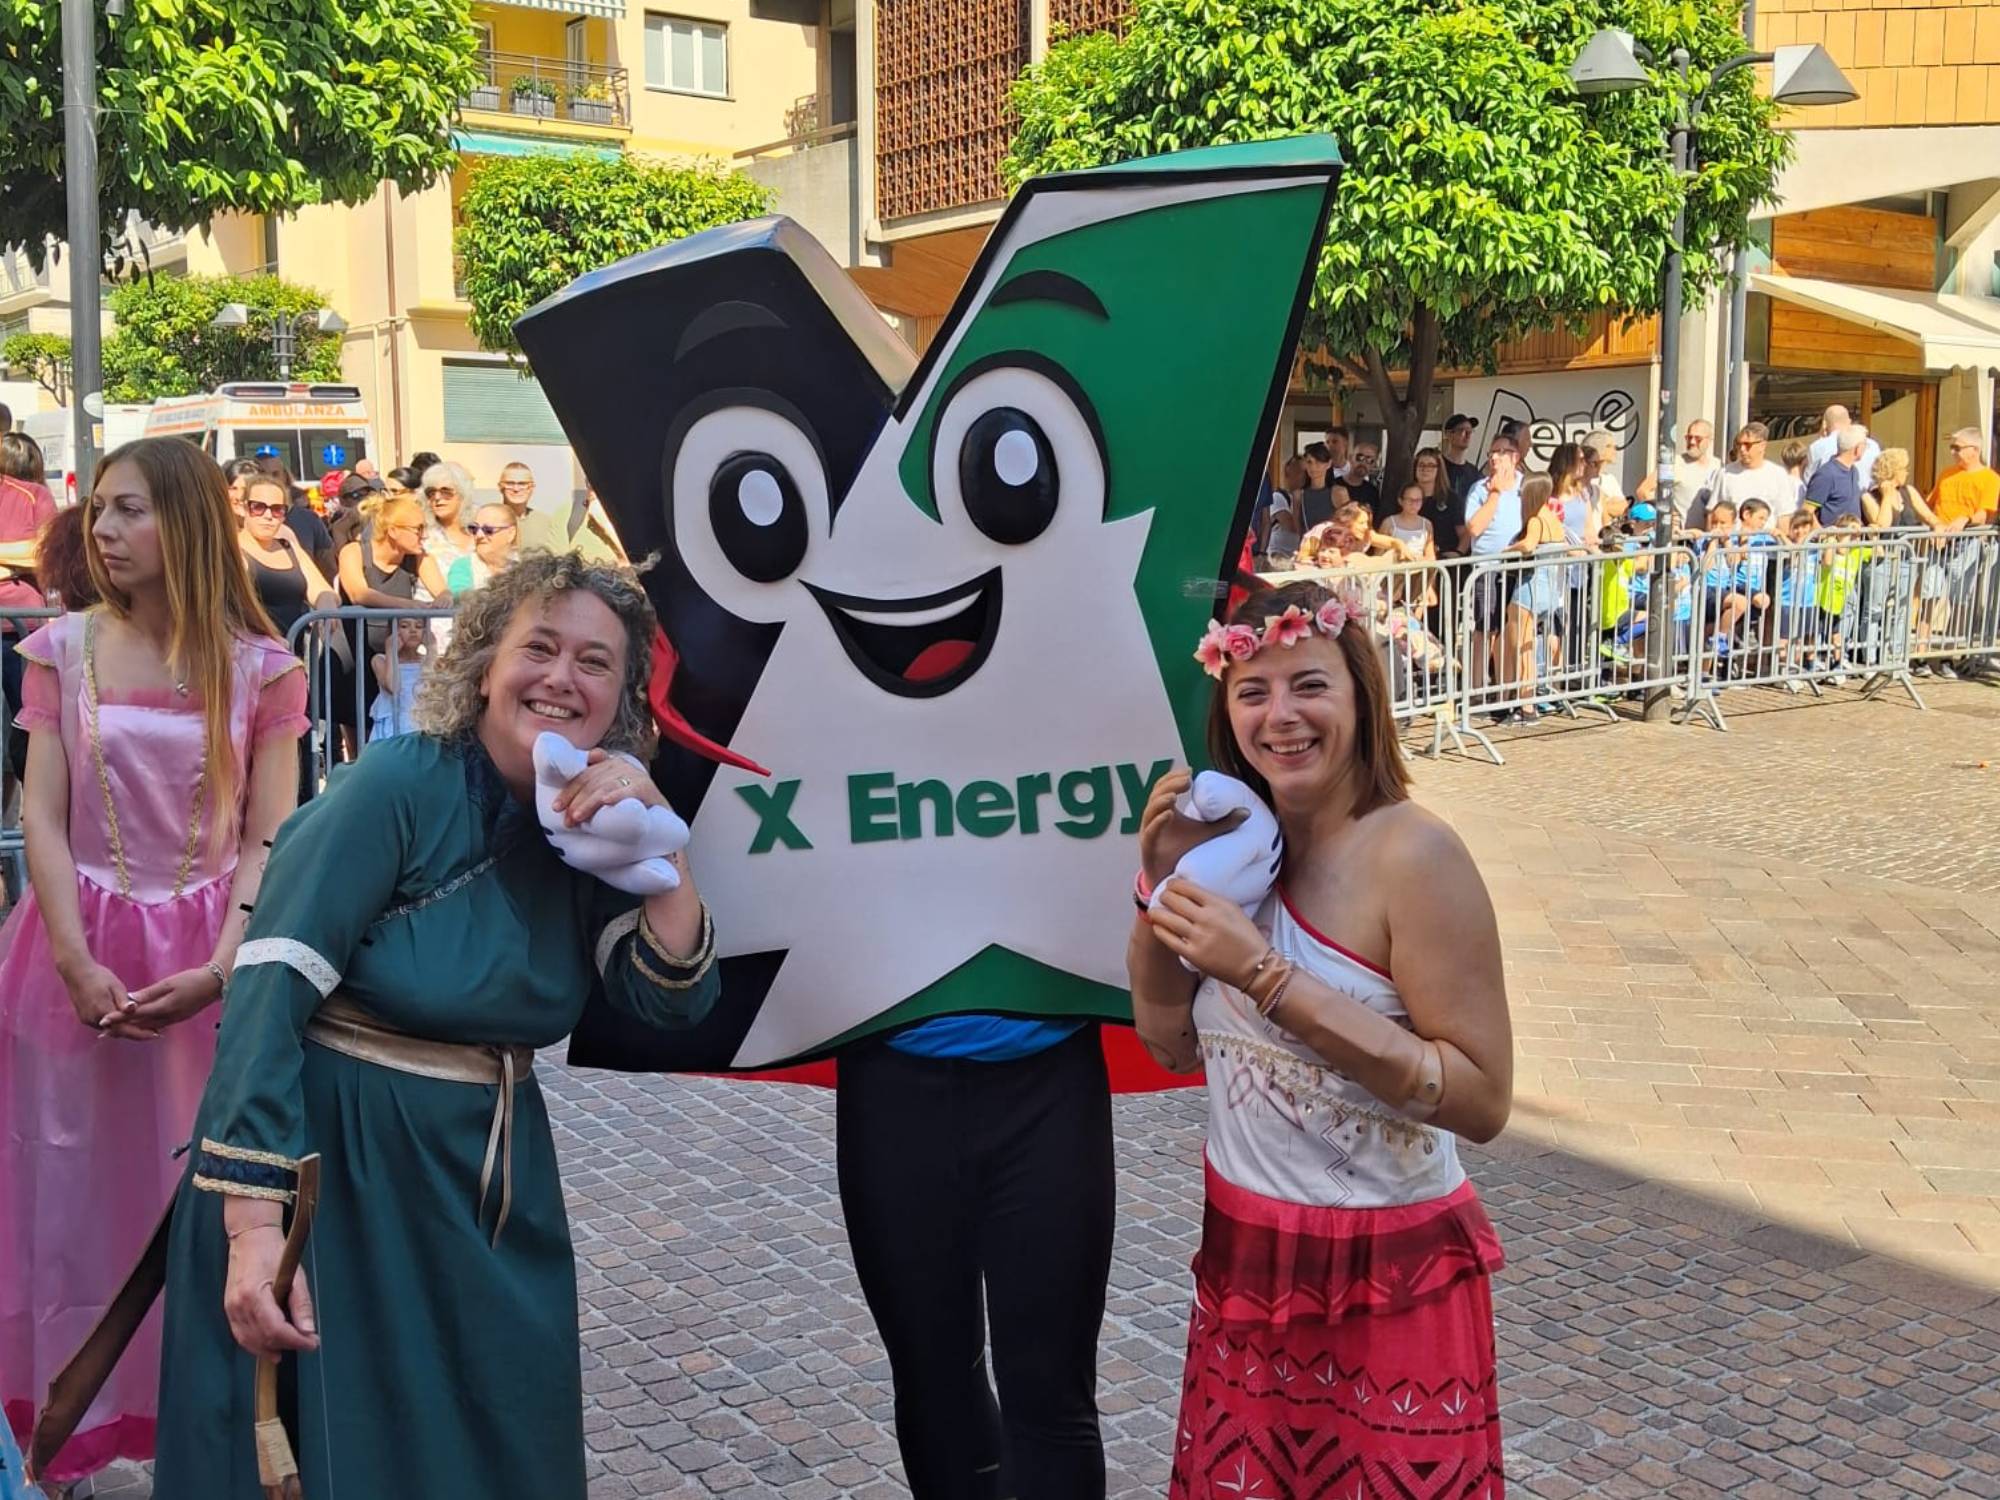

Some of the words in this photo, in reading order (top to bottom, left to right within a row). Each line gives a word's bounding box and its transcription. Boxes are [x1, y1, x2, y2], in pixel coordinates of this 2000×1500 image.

[249, 404, 345, 416] AMBULANZA
[734, 779, 814, 854] X
[847, 758, 1175, 843] Energy
